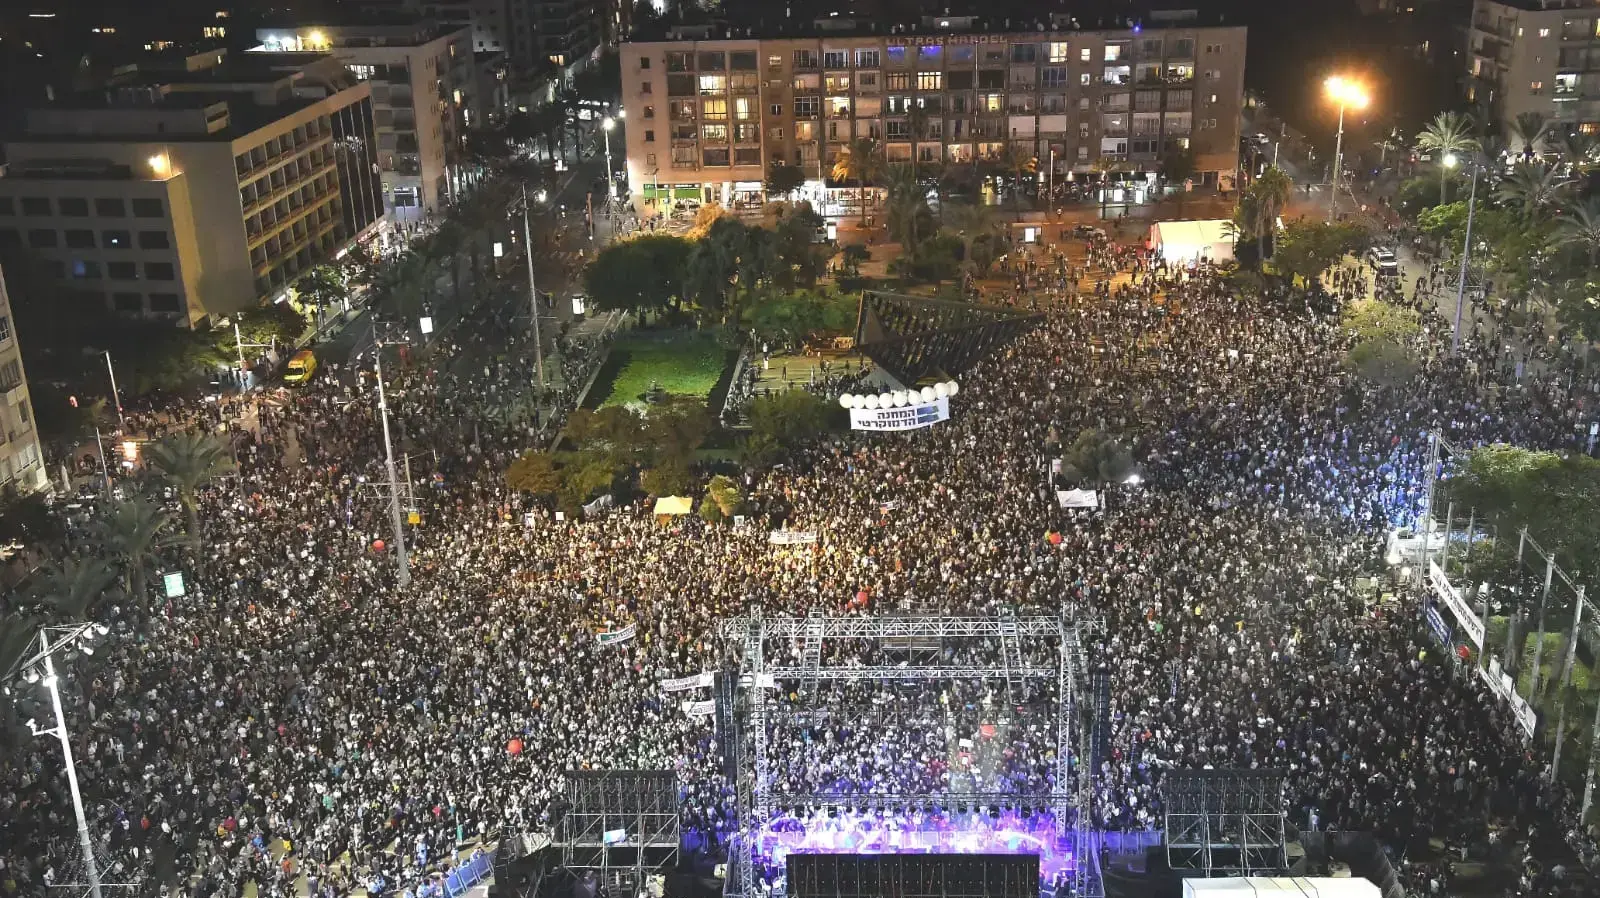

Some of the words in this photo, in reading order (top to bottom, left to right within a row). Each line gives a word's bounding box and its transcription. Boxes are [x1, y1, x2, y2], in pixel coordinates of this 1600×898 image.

[886, 37, 943, 46] ULTRAS
[948, 35, 1007, 44] HAPOEL
[877, 409, 915, 419] המחנה
[858, 418, 916, 429] הדמוקרטי
